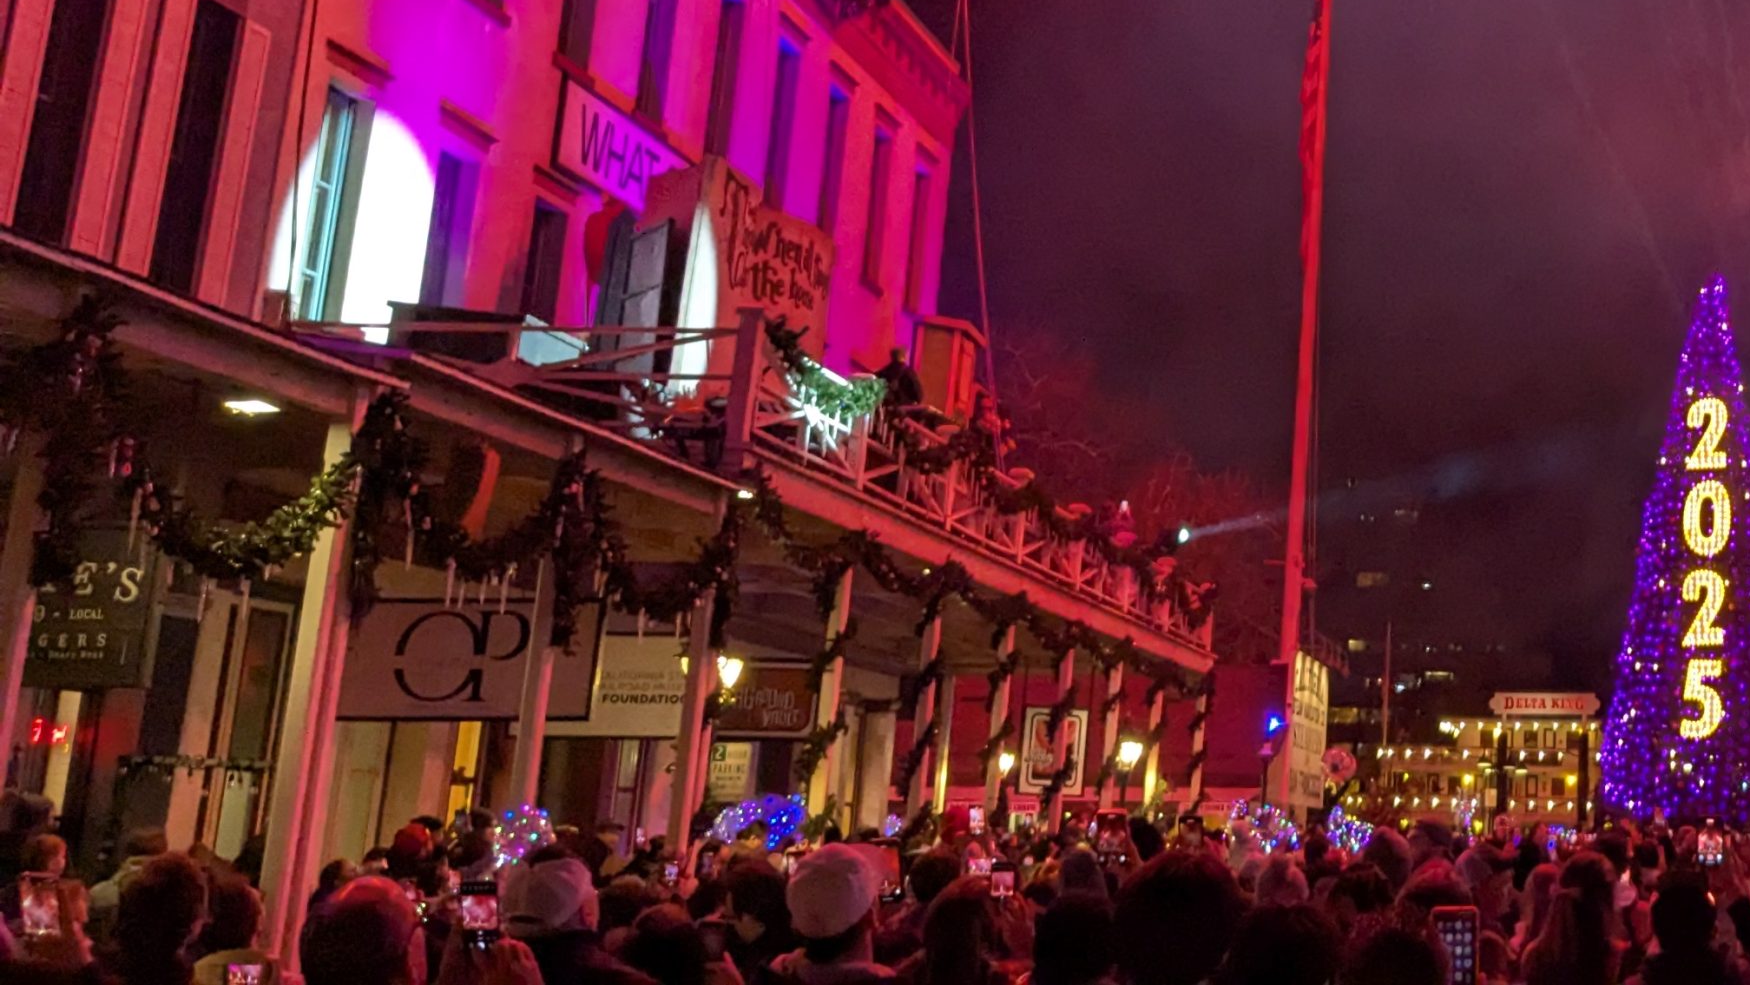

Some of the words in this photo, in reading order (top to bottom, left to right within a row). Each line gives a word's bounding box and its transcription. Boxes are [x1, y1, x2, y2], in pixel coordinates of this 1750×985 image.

[1679, 397, 1732, 740] 2025
[68, 608, 104, 620] LOCAL
[37, 633, 107, 648] GERS
[1504, 696, 1547, 710] DELTA
[1551, 696, 1584, 710] KING
[715, 746, 724, 759] 2
